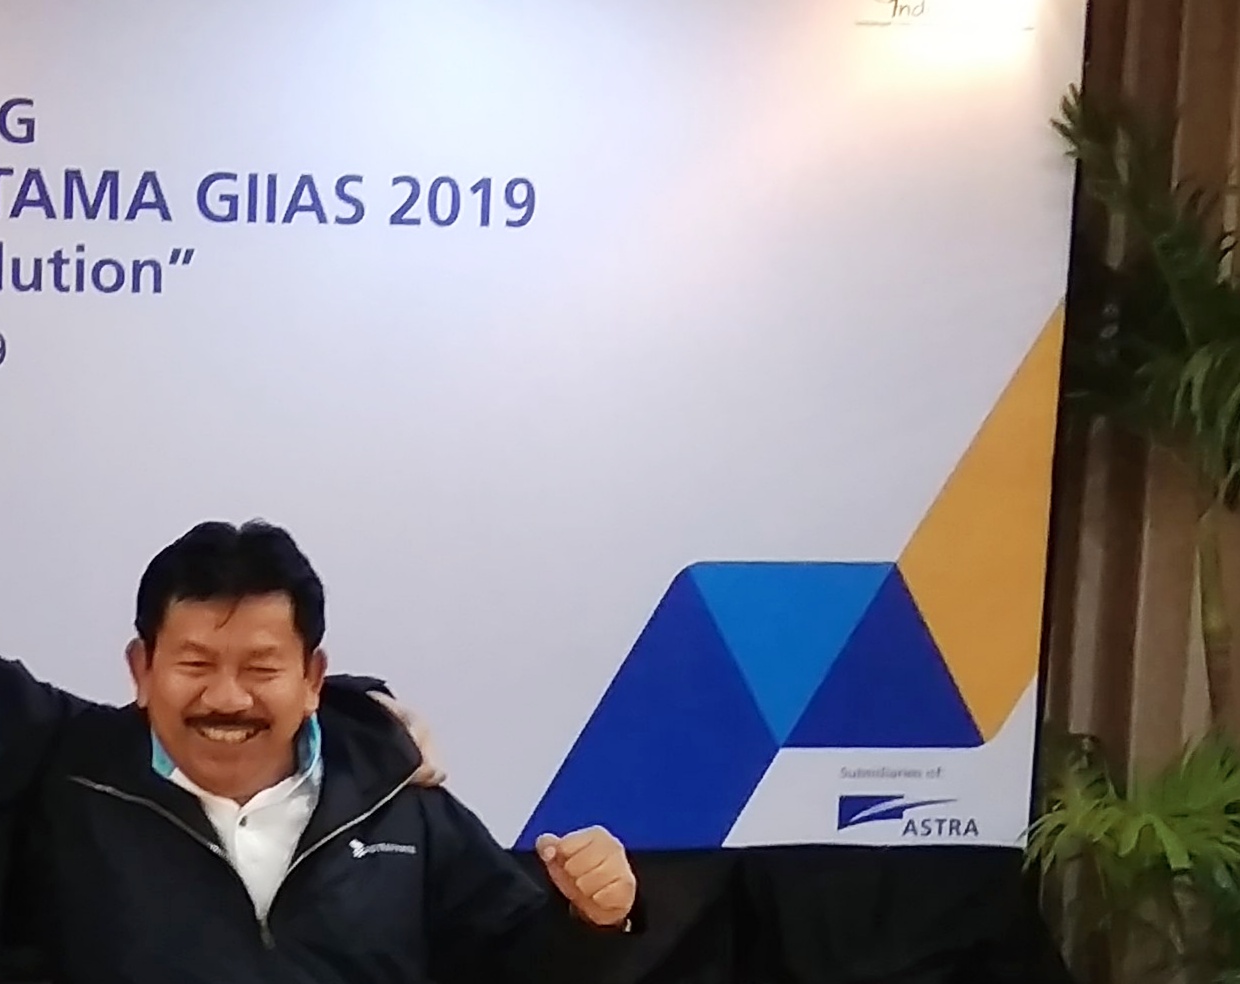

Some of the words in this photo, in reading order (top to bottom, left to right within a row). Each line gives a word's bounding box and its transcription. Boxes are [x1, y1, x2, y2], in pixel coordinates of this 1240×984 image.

[196, 171, 366, 226] GIIAS
[388, 174, 536, 229] 2019
[902, 818, 980, 837] ASTRA
